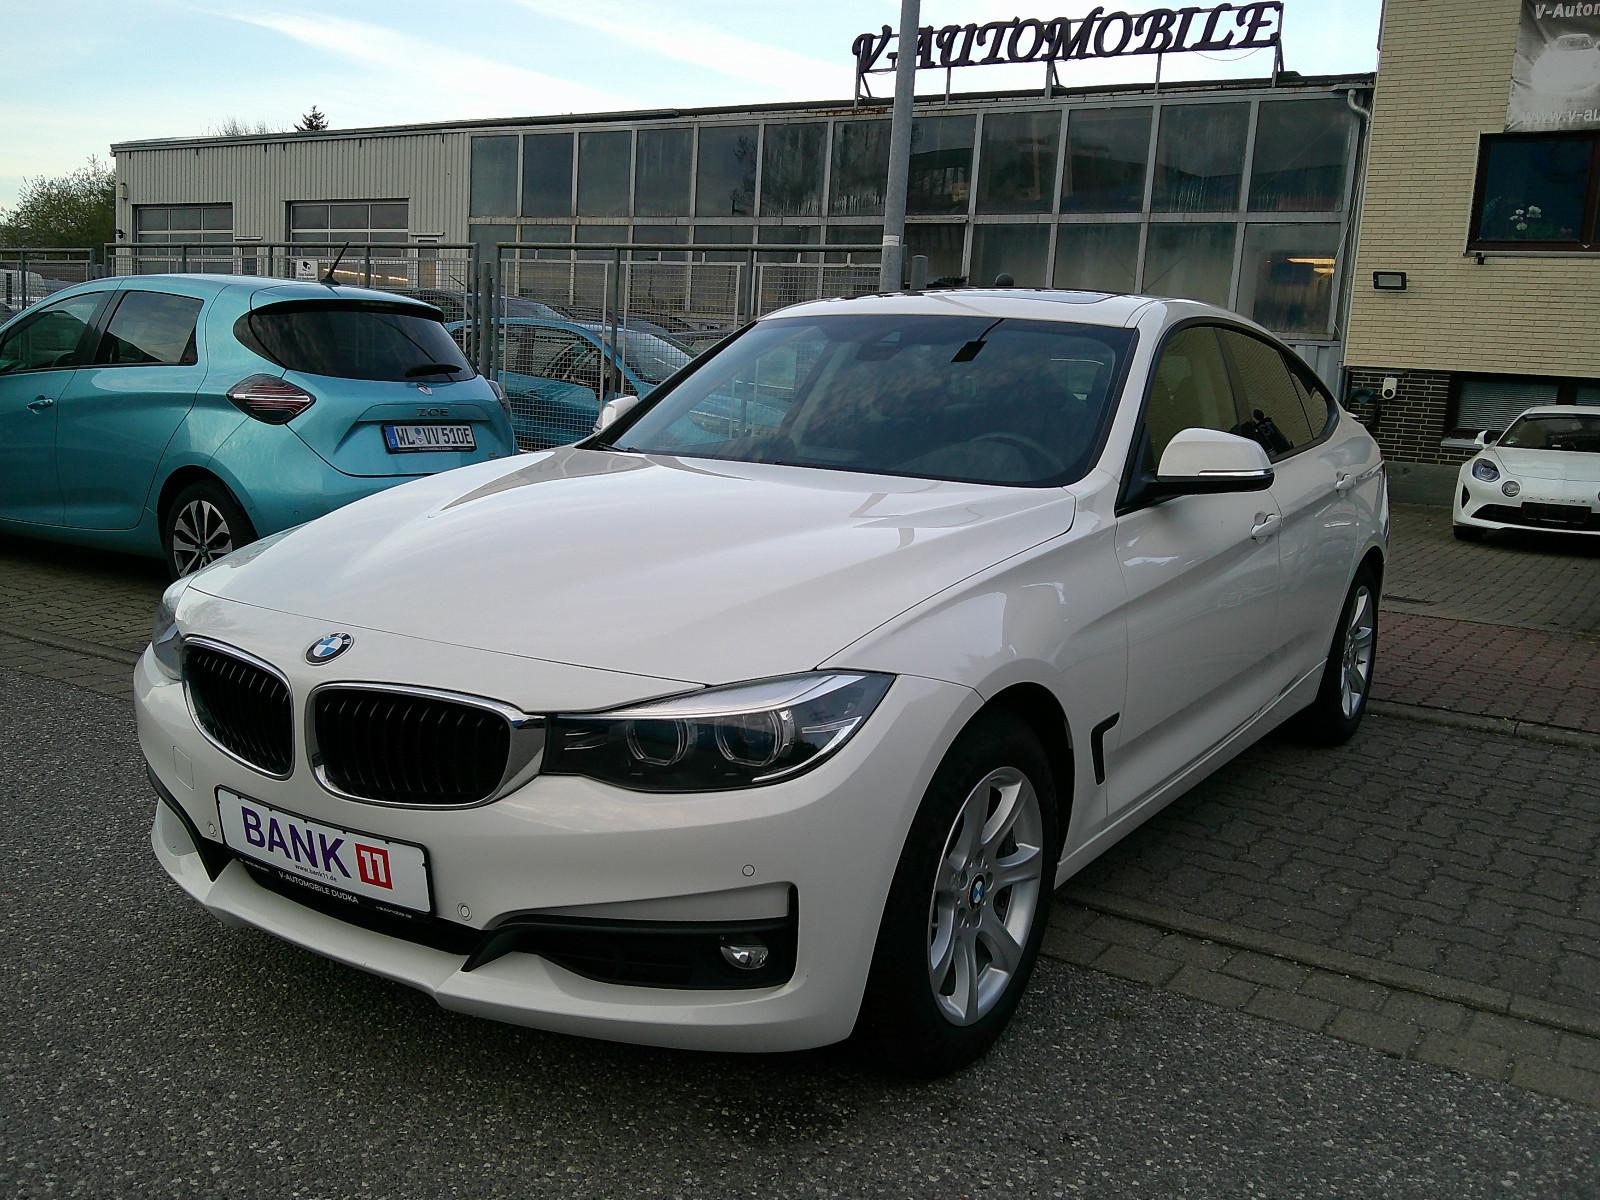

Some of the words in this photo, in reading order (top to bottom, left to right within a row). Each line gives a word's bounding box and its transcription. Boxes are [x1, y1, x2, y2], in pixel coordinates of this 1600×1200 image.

[852, 2, 1282, 73] V-AUTOMOBILE
[395, 427, 416, 446] WL
[241, 806, 352, 879] BANK
[359, 849, 388, 885] 11
[278, 870, 331, 896] V-AUTOMOBILE
[331, 889, 360, 905] DUDKA
